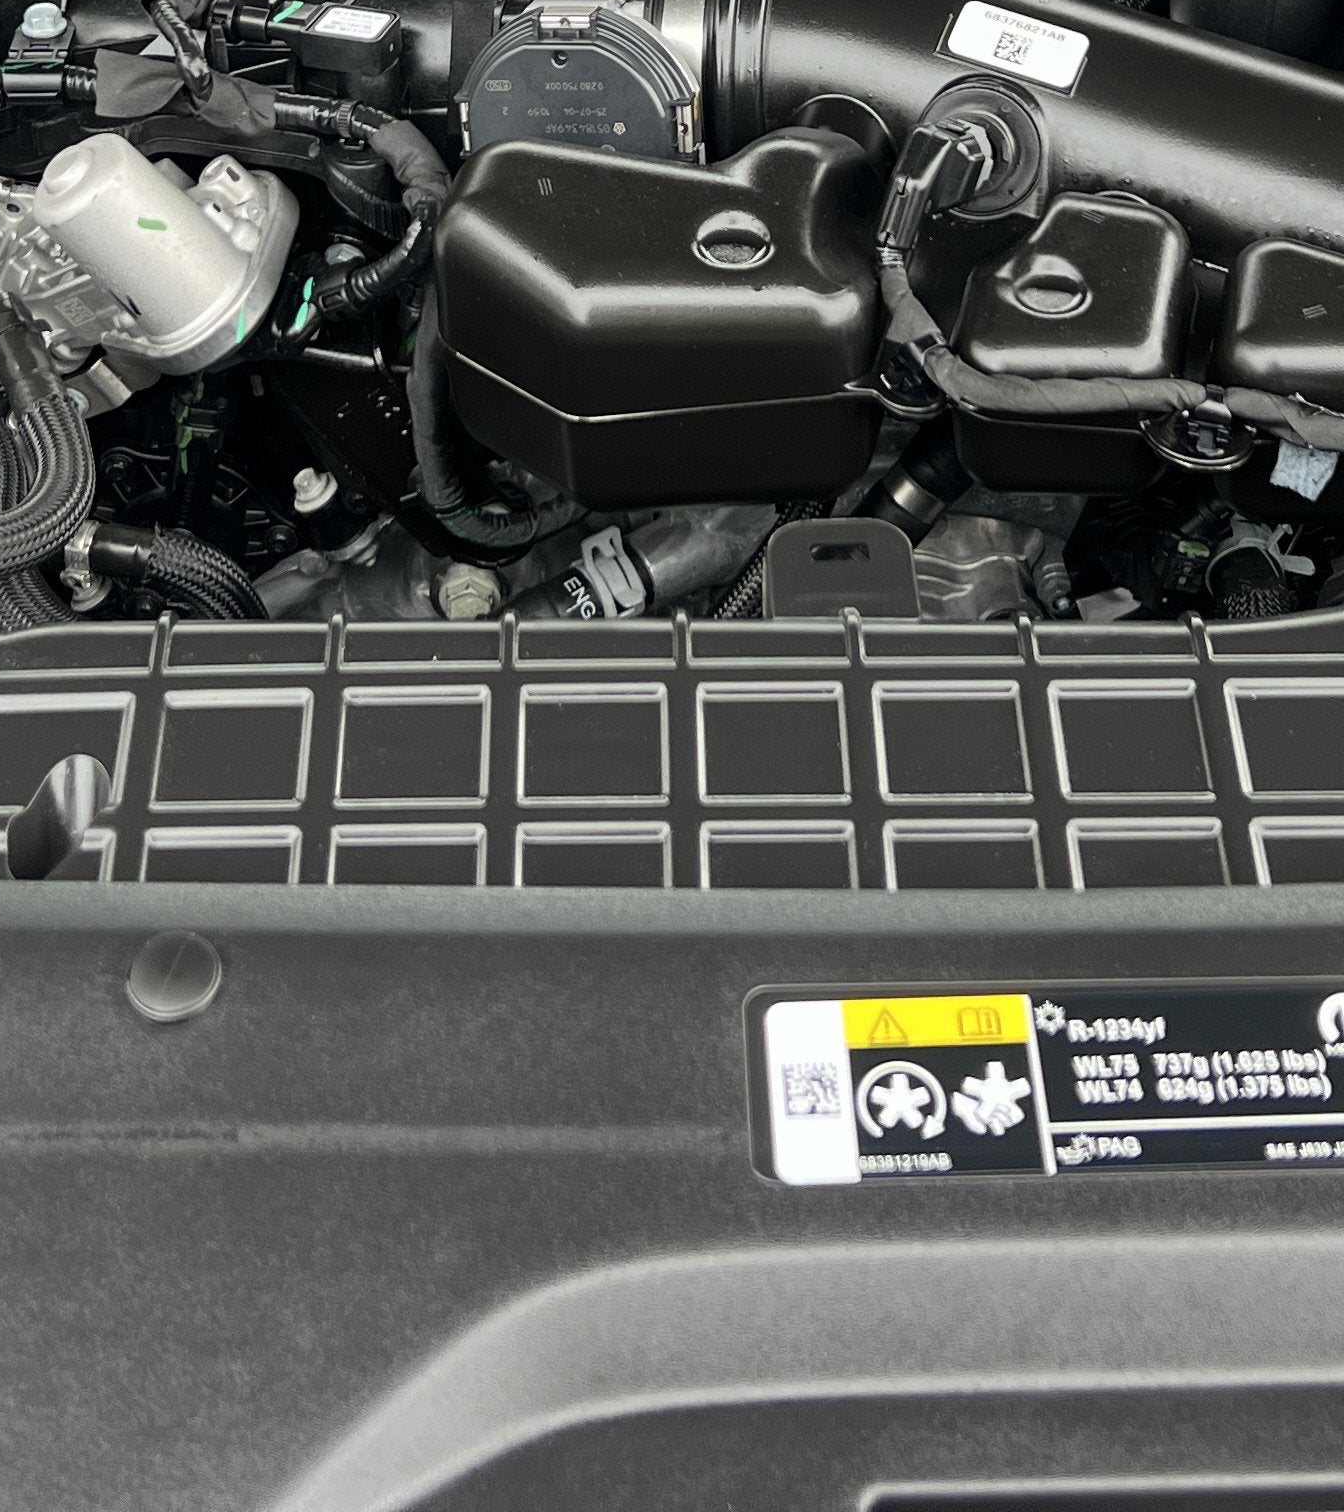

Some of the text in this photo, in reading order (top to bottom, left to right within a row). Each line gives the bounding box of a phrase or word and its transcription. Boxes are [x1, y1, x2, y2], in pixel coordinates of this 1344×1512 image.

[1066, 1016, 1168, 1046] R-1234yf
[1072, 1048, 1327, 1080] WL75 737g (1.625 lbs)
[1076, 1072, 1333, 1105] WL74 624g (1.375 lbs)
[1097, 1135, 1143, 1159] PAG
